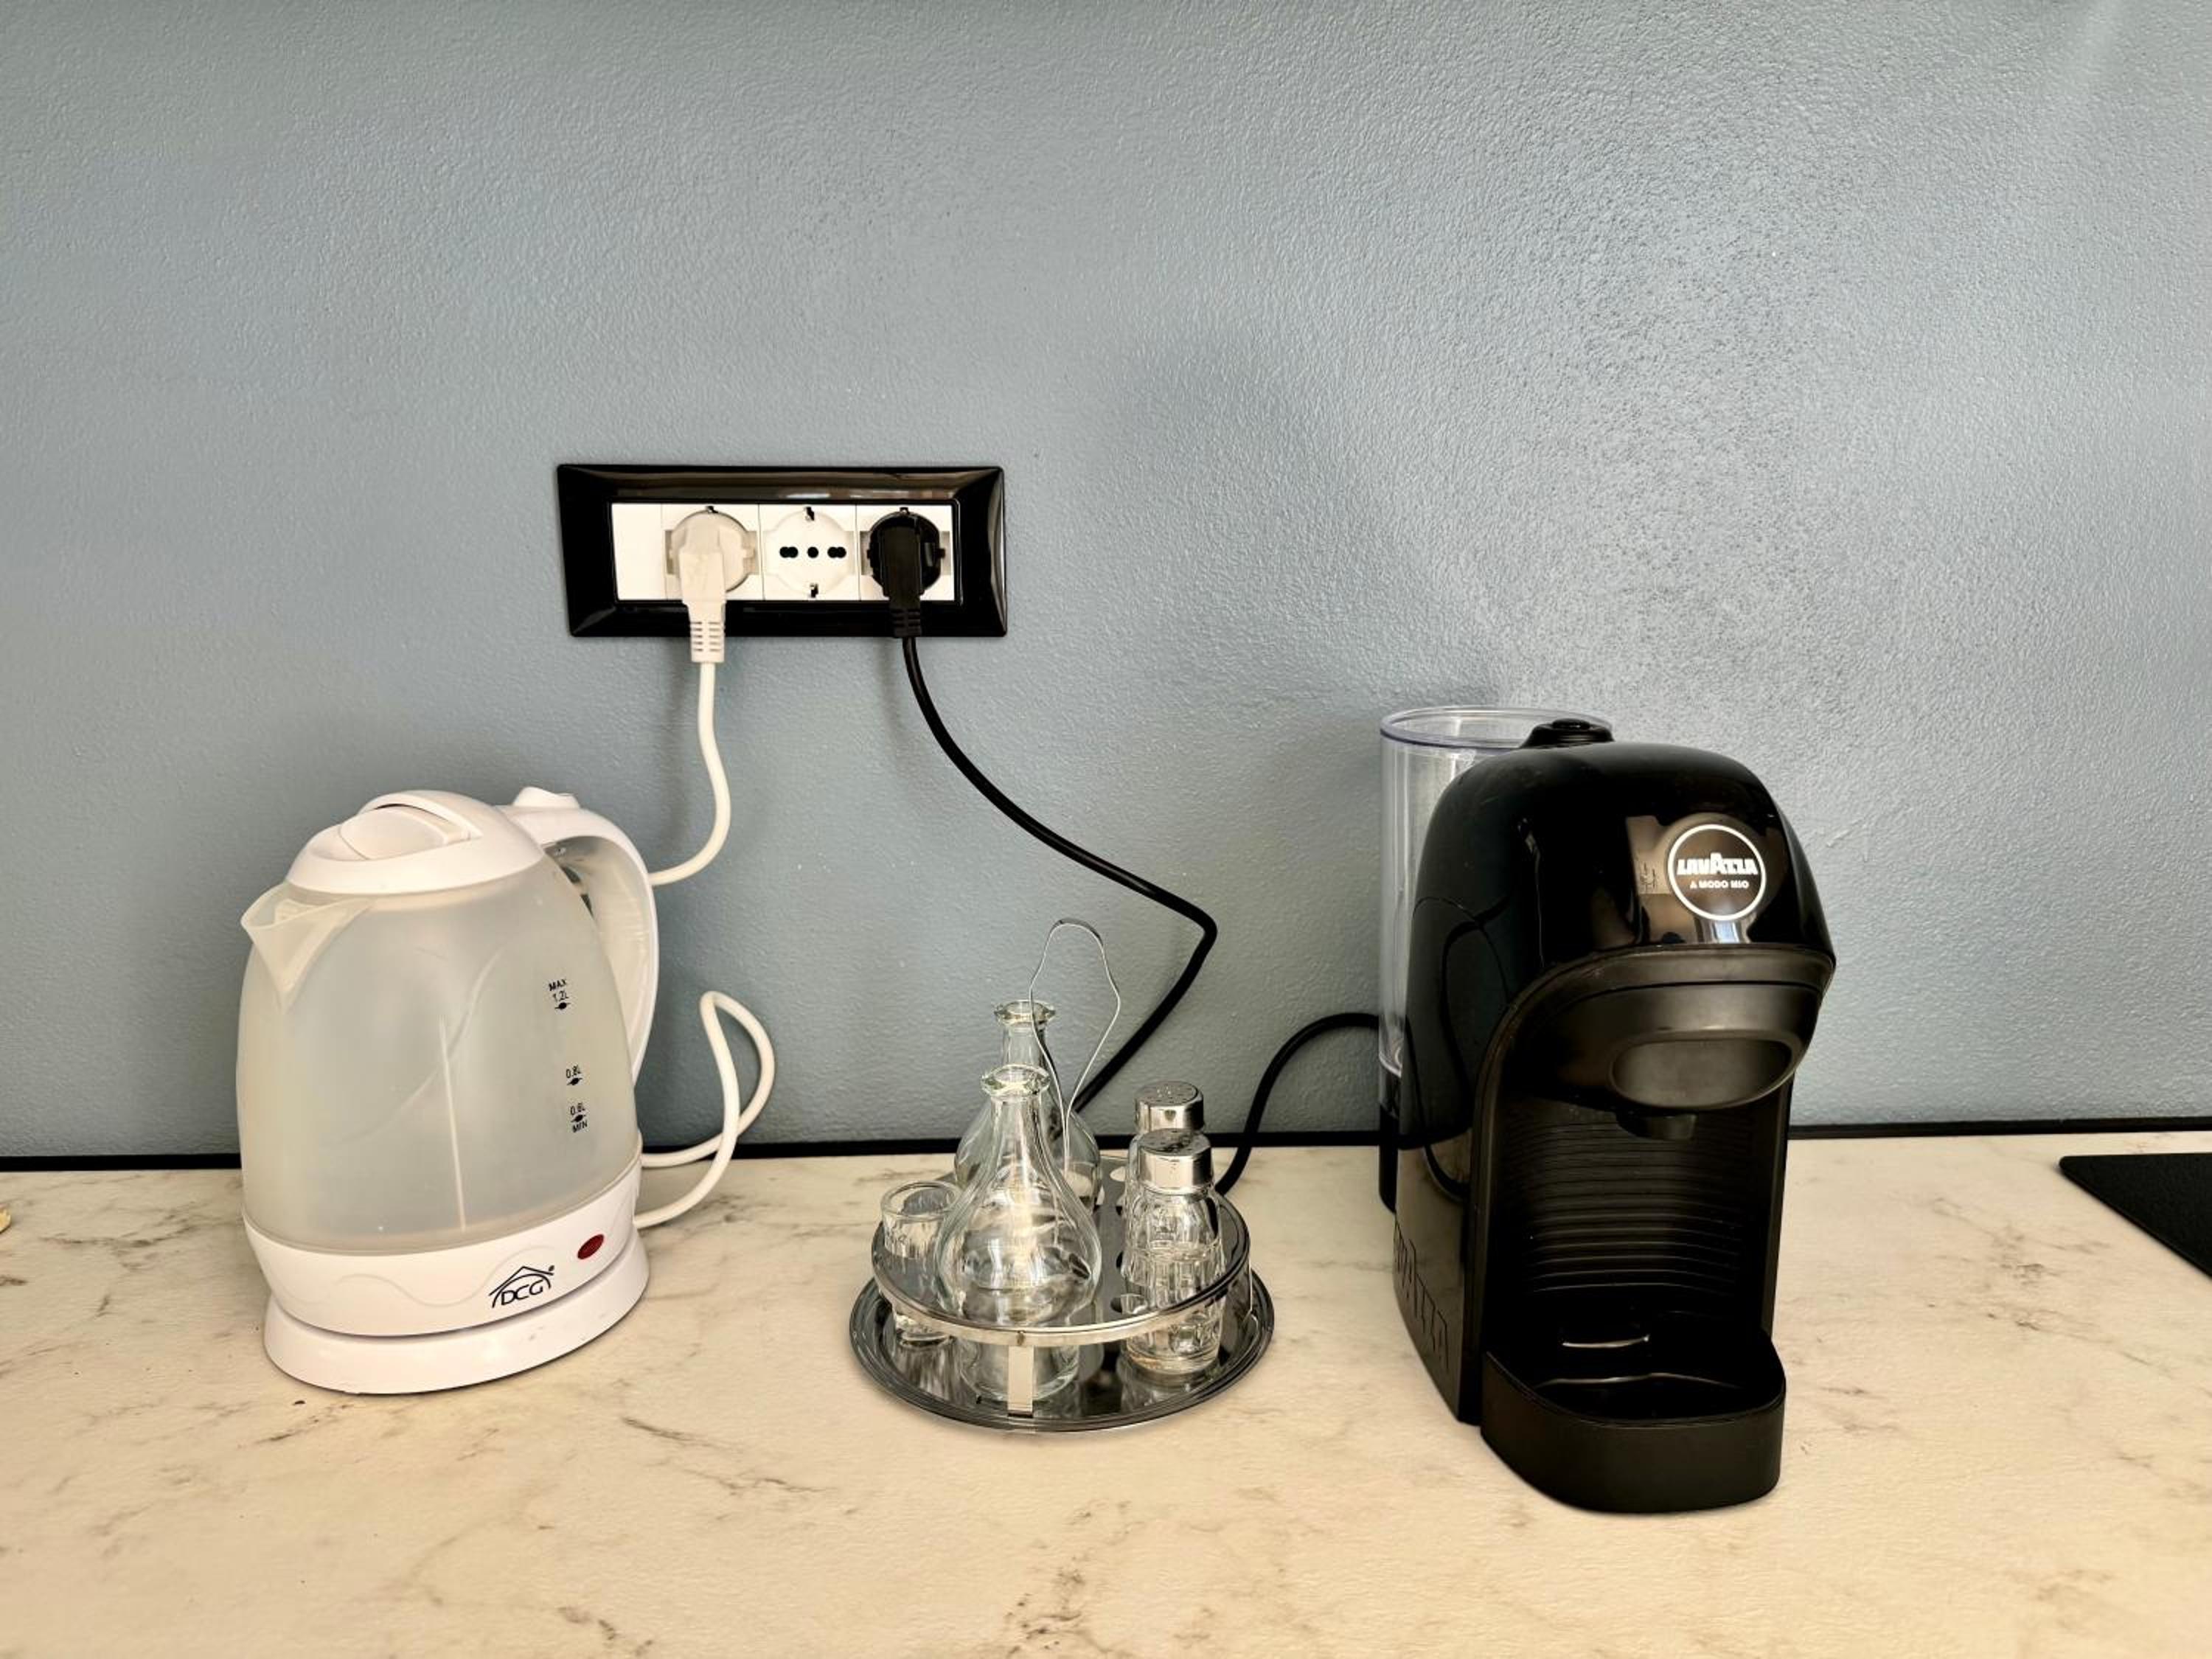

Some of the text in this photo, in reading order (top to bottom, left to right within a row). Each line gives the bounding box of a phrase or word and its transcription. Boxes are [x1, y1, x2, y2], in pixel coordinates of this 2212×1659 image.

[1677, 852, 1758, 875] LAVAZZA
[1690, 880, 1750, 888] A MODO MIO
[549, 978, 567, 991] MAX
[572, 1120, 588, 1133] MIN
[501, 1279, 543, 1306] DCG
